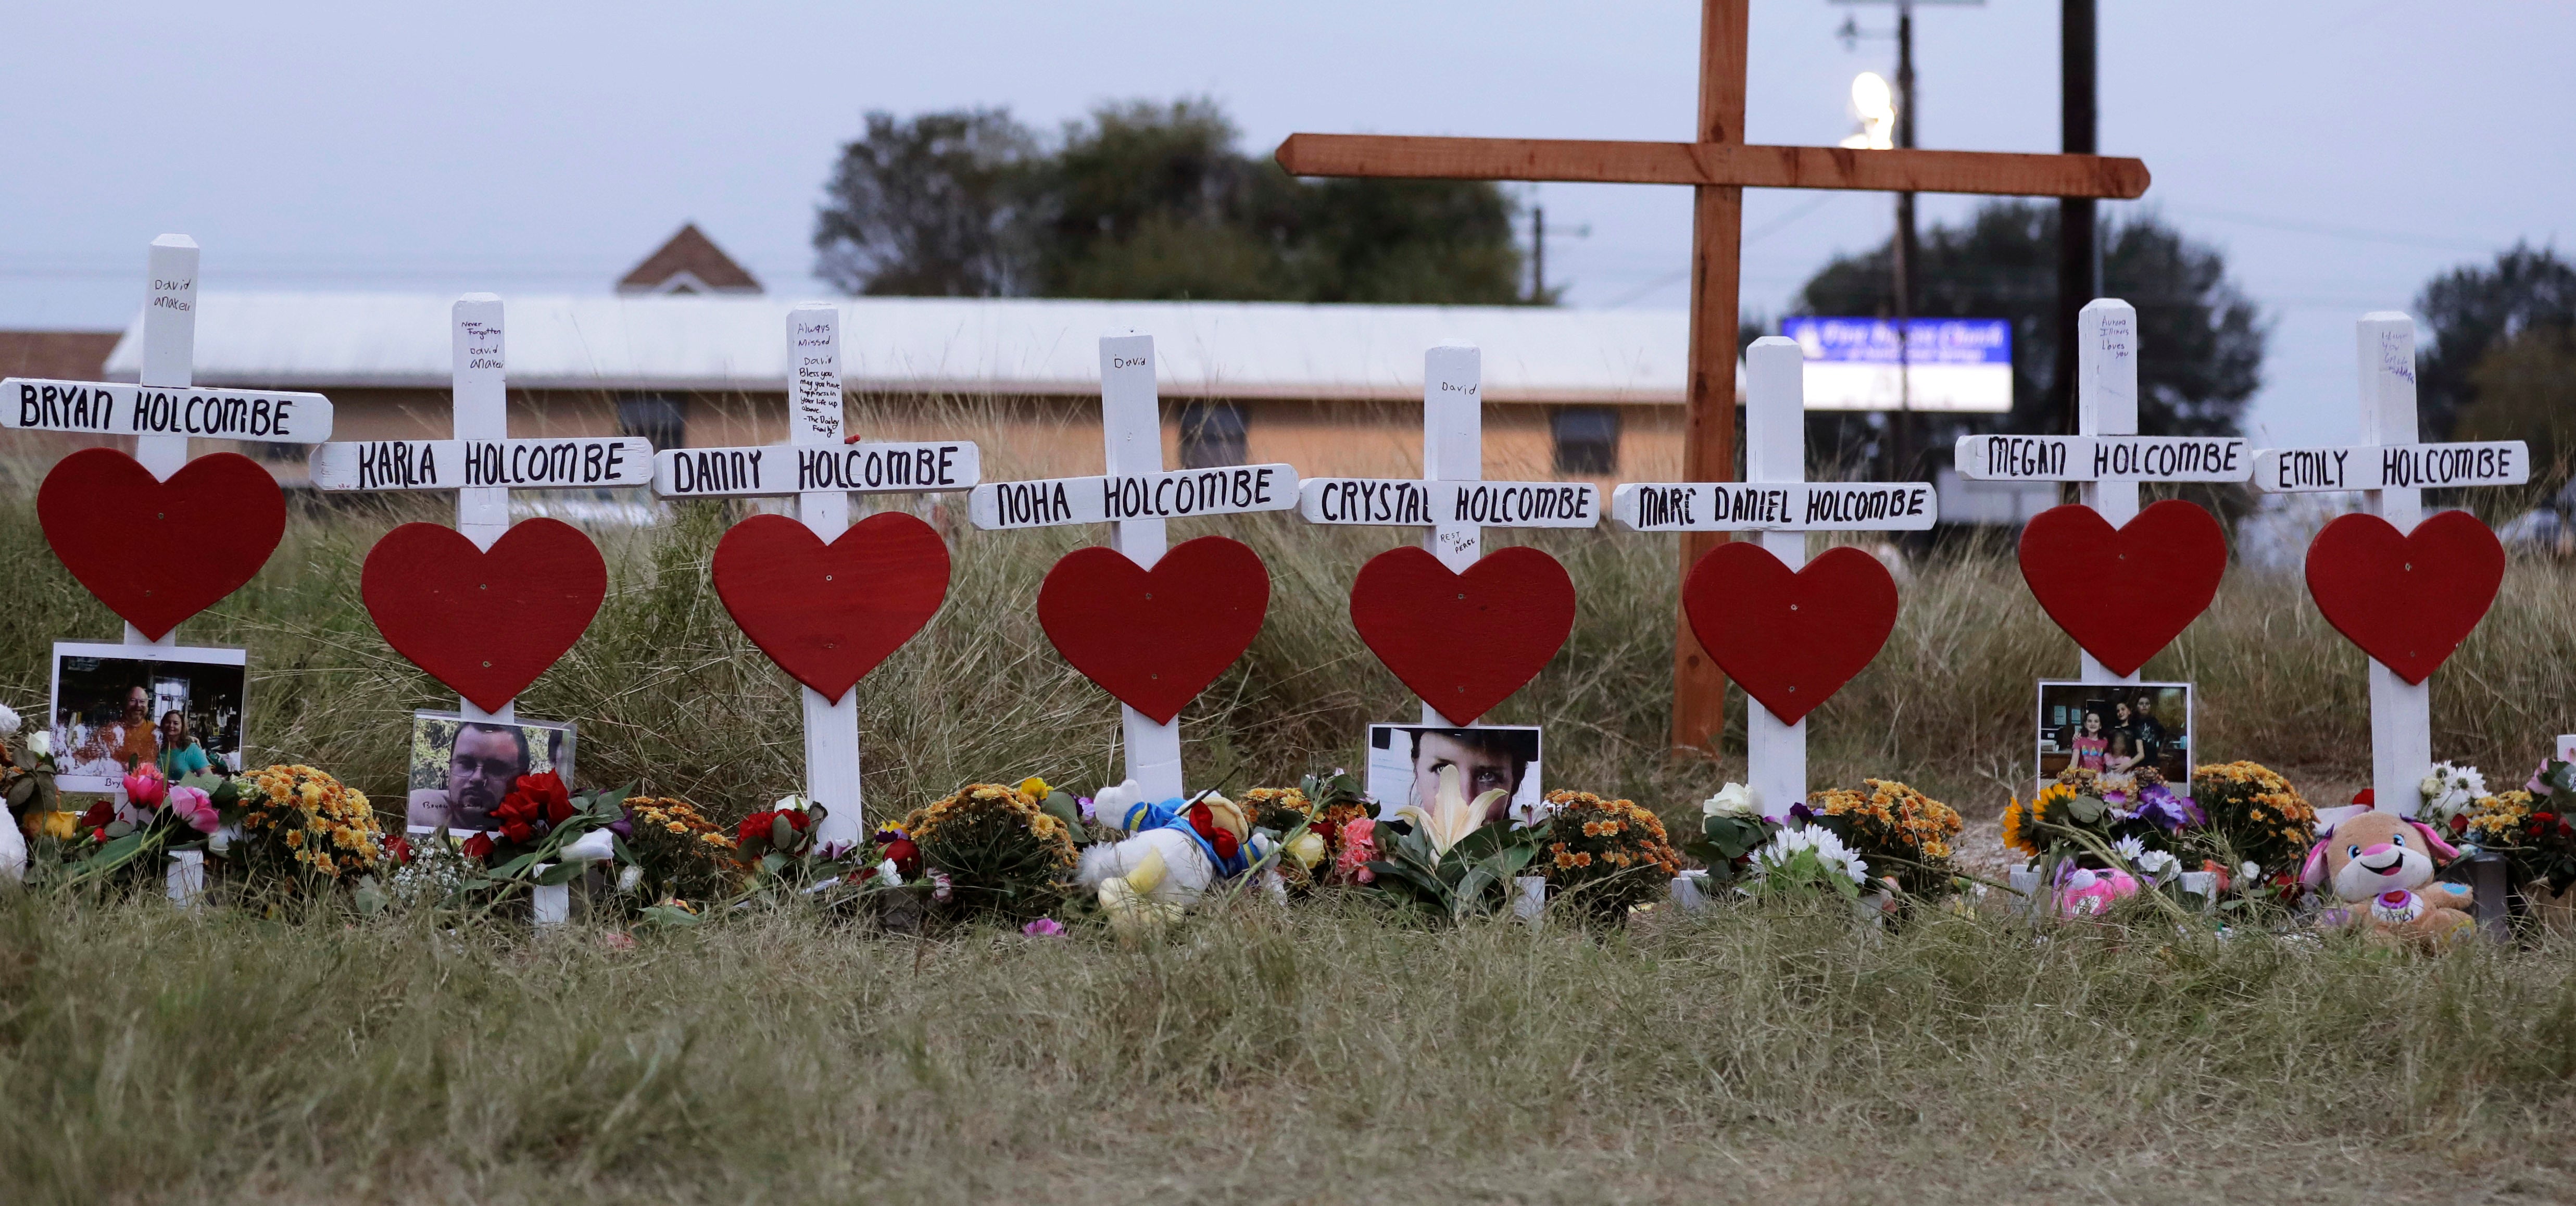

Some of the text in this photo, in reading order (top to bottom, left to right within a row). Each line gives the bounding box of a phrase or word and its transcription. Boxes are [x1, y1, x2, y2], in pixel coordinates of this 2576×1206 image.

[155, 279, 191, 290] David
[467, 328, 501, 340] Forgotten
[797, 323, 830, 334] Always
[798, 335, 831, 346] Missed
[470, 345, 498, 354] David
[804, 355, 832, 365] David
[1114, 357, 1146, 368] David
[799, 368, 819, 377] Bless
[1442, 382, 1477, 395] David
[20, 385, 293, 435] BRYAN HOLCOMBE
[1988, 436, 2243, 478] MEGAN HOLCOMBE
[359, 442, 624, 488] KARLA HOLCOMBE
[674, 447, 959, 493] DANNY HOLCOMBE
[2279, 448, 2512, 488] EMILY HOLCOMBE
[1104, 469, 1274, 518] HOLCOMBE
[1322, 480, 1591, 523] CRYSTAL HOLCOMBE
[1638, 486, 1927, 528] MARC DANIEL HOLCOMBE
[1440, 531, 1460, 543] REST
